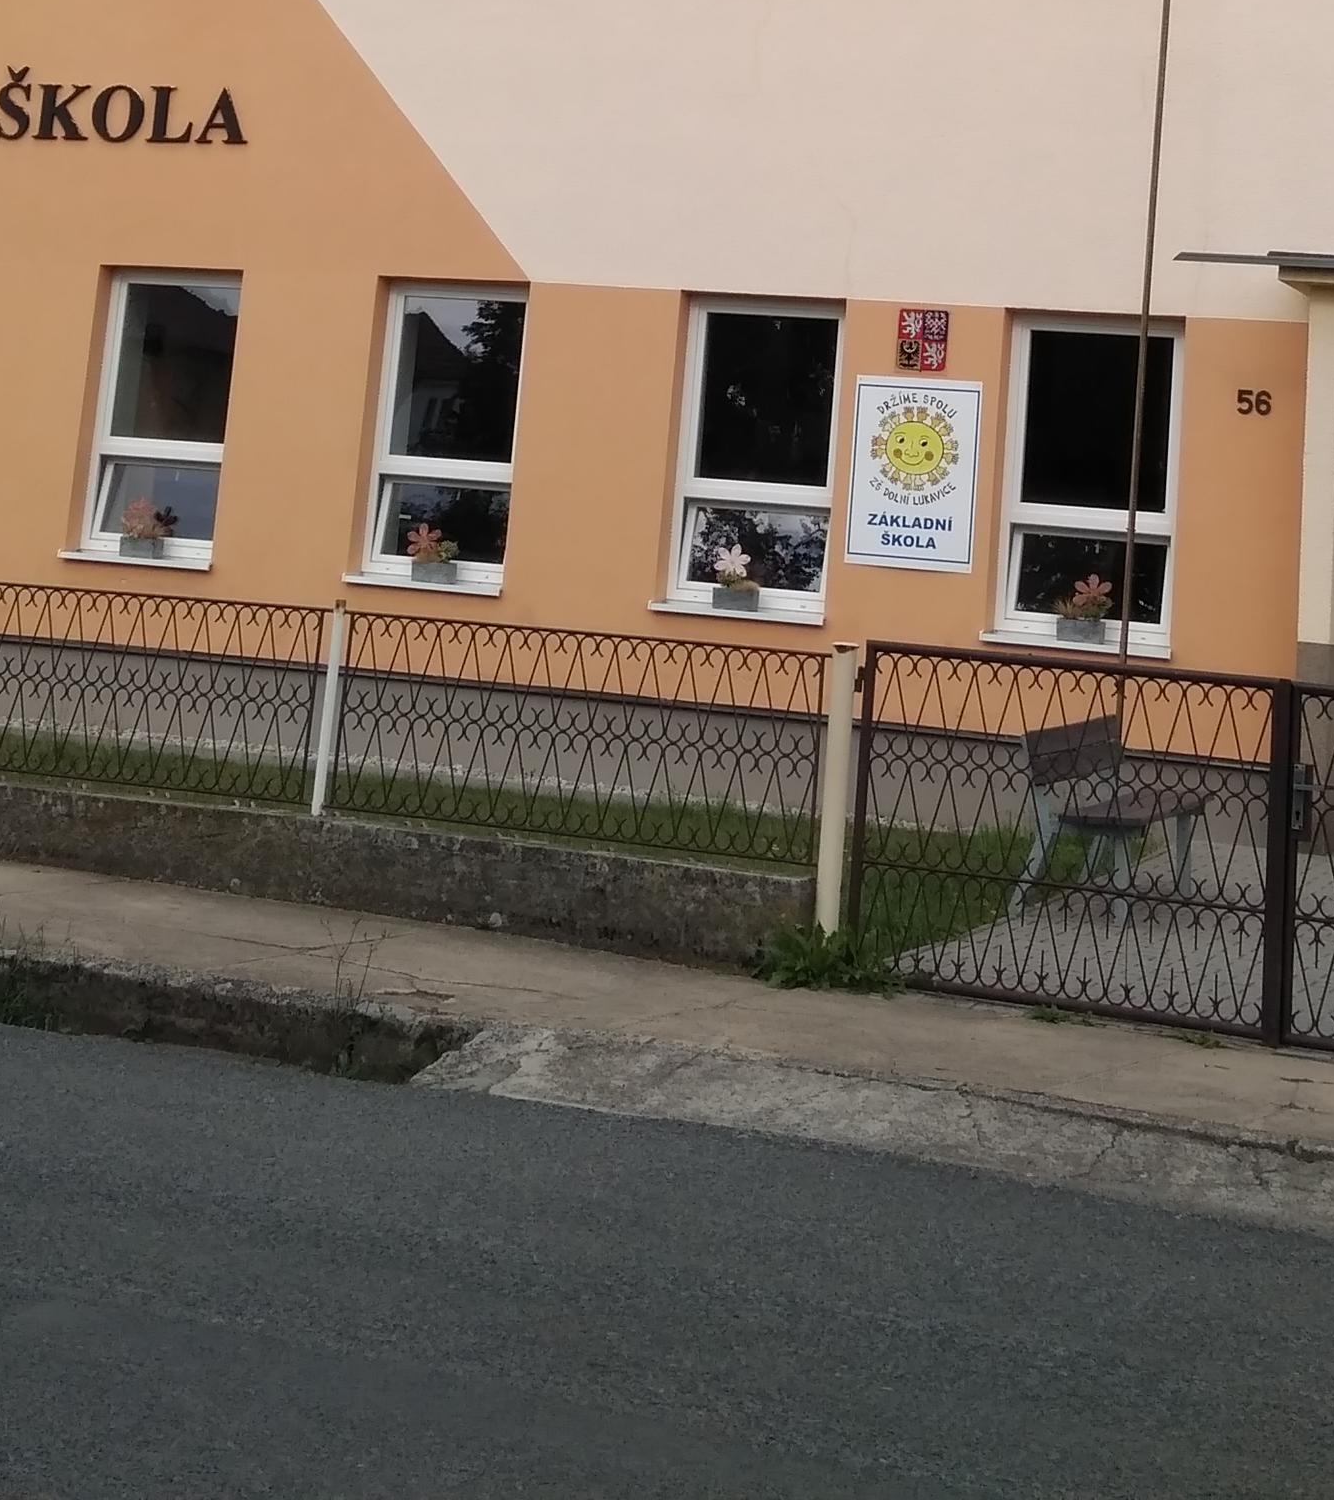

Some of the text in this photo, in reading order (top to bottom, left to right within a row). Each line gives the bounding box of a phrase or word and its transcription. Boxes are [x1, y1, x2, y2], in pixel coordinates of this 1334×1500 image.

[876, 390, 957, 418] DRŽÍME SPOLU
[1236, 388, 1272, 416] 56
[883, 487, 910, 505] DOLNÍ
[912, 482, 957, 506] LUKAVICE
[867, 511, 954, 532] ZÁKLADNÍ
[880, 530, 937, 550] ŠKOLA
